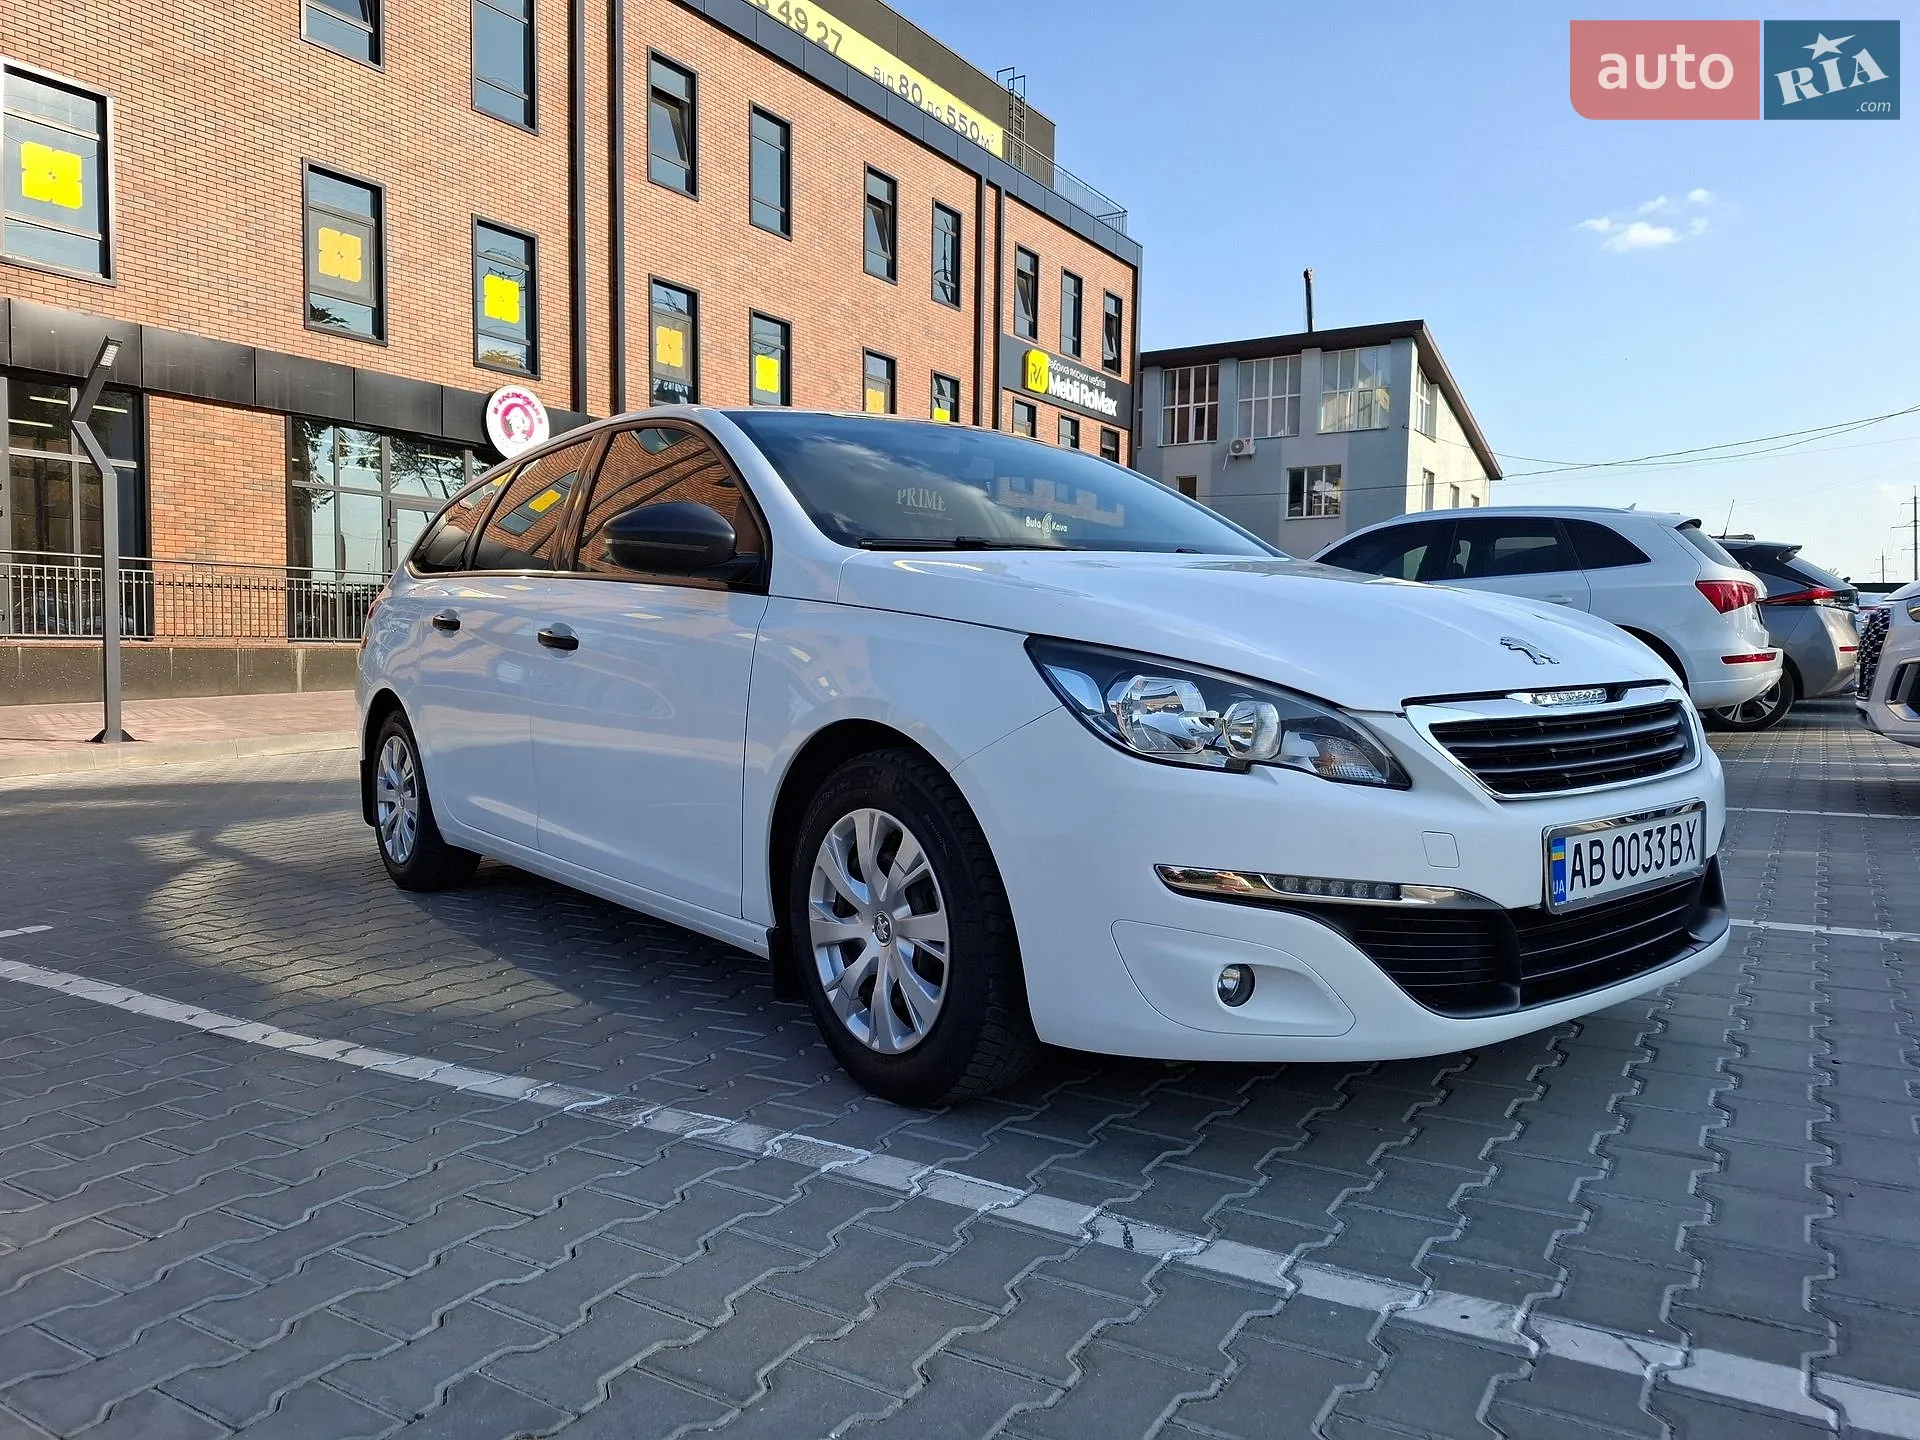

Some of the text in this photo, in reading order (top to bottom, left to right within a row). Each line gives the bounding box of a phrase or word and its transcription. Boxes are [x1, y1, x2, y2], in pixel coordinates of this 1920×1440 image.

[778, 0, 843, 55] 49 27
[899, 74, 923, 105] 80
[1048, 372, 1117, 417] Mebli RoMax
[896, 487, 946, 511] PRIME
[1553, 880, 1565, 895] UA
